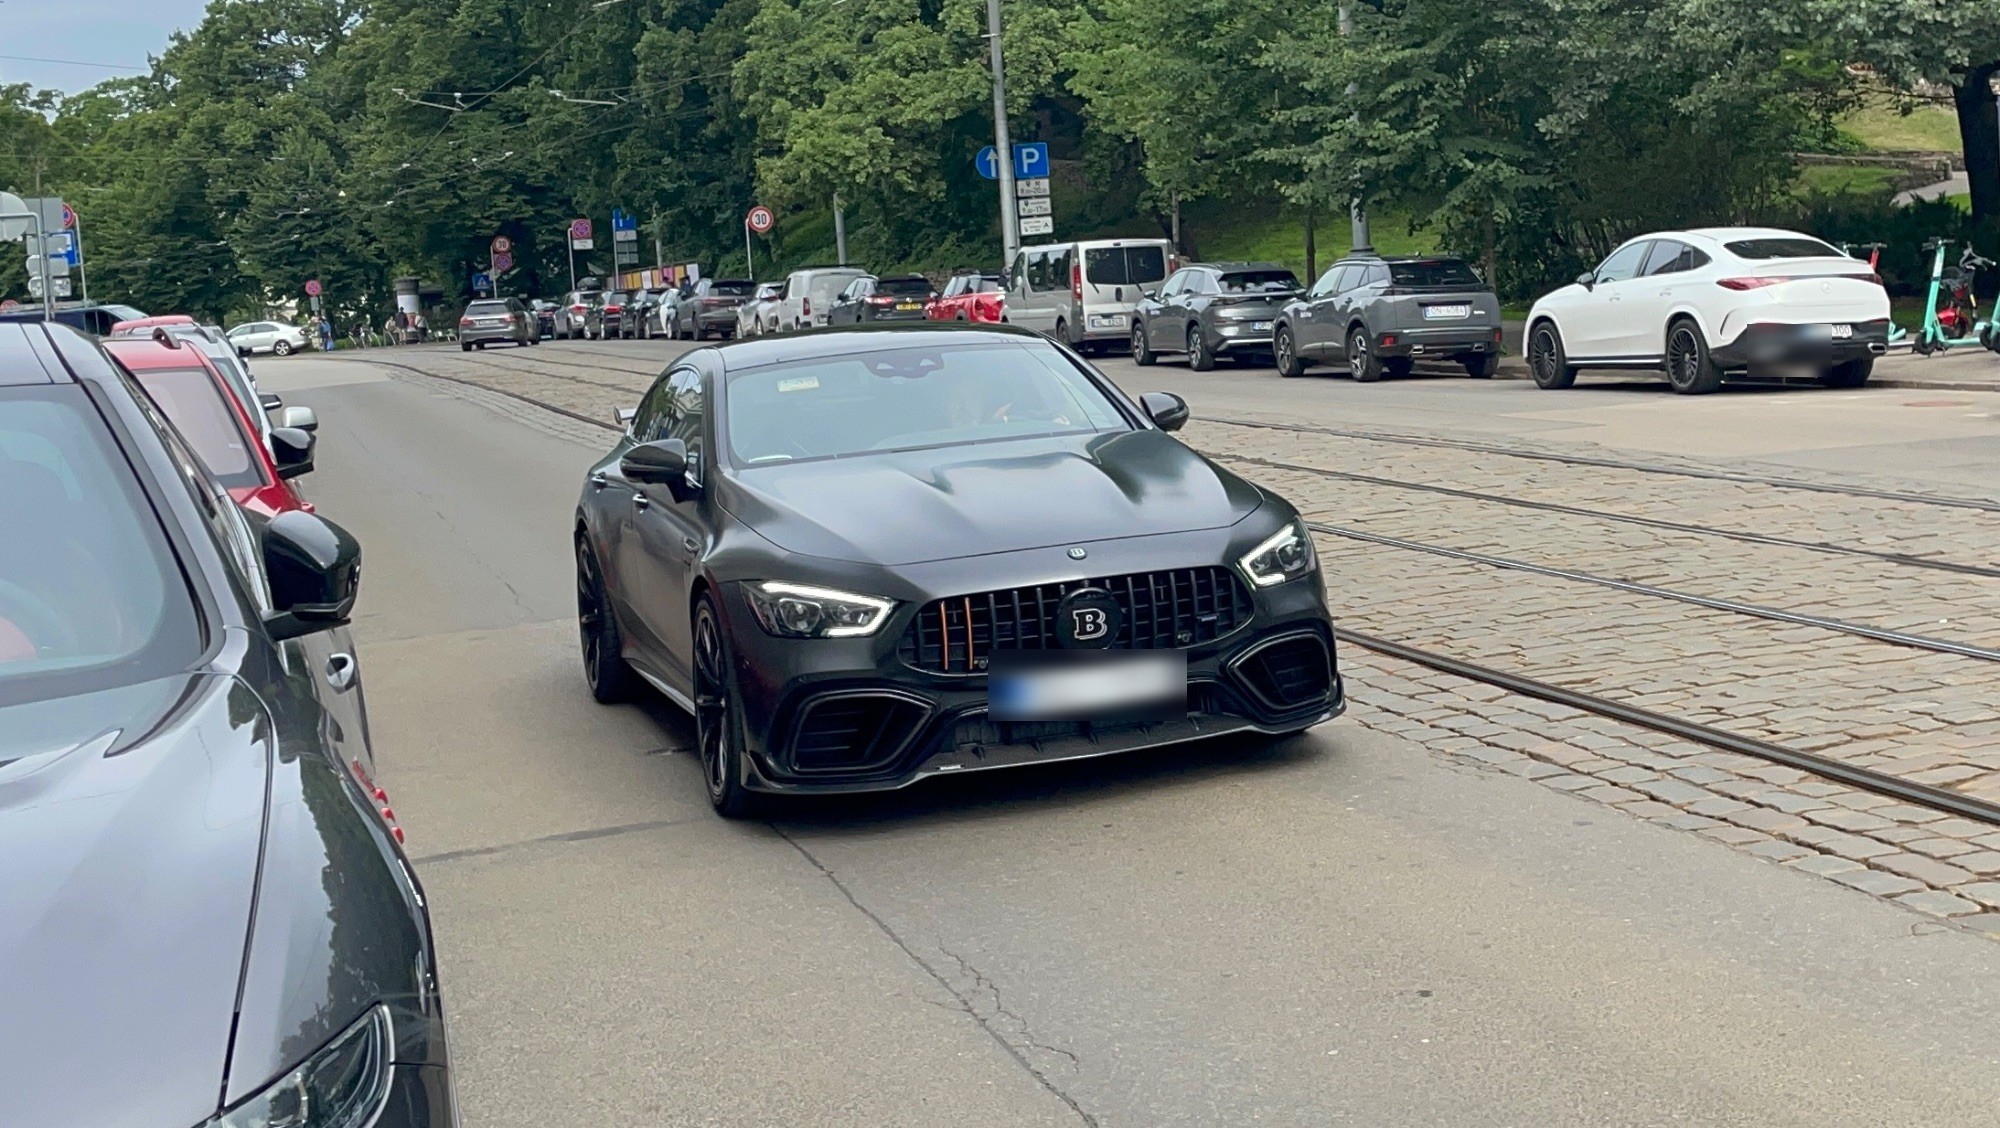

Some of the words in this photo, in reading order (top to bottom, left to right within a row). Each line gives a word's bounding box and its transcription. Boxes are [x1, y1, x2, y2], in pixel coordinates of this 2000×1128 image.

[1021, 147, 1040, 174] P
[755, 213, 767, 225] 30
[497, 240, 507, 249] 30
[1072, 607, 1108, 640] B
